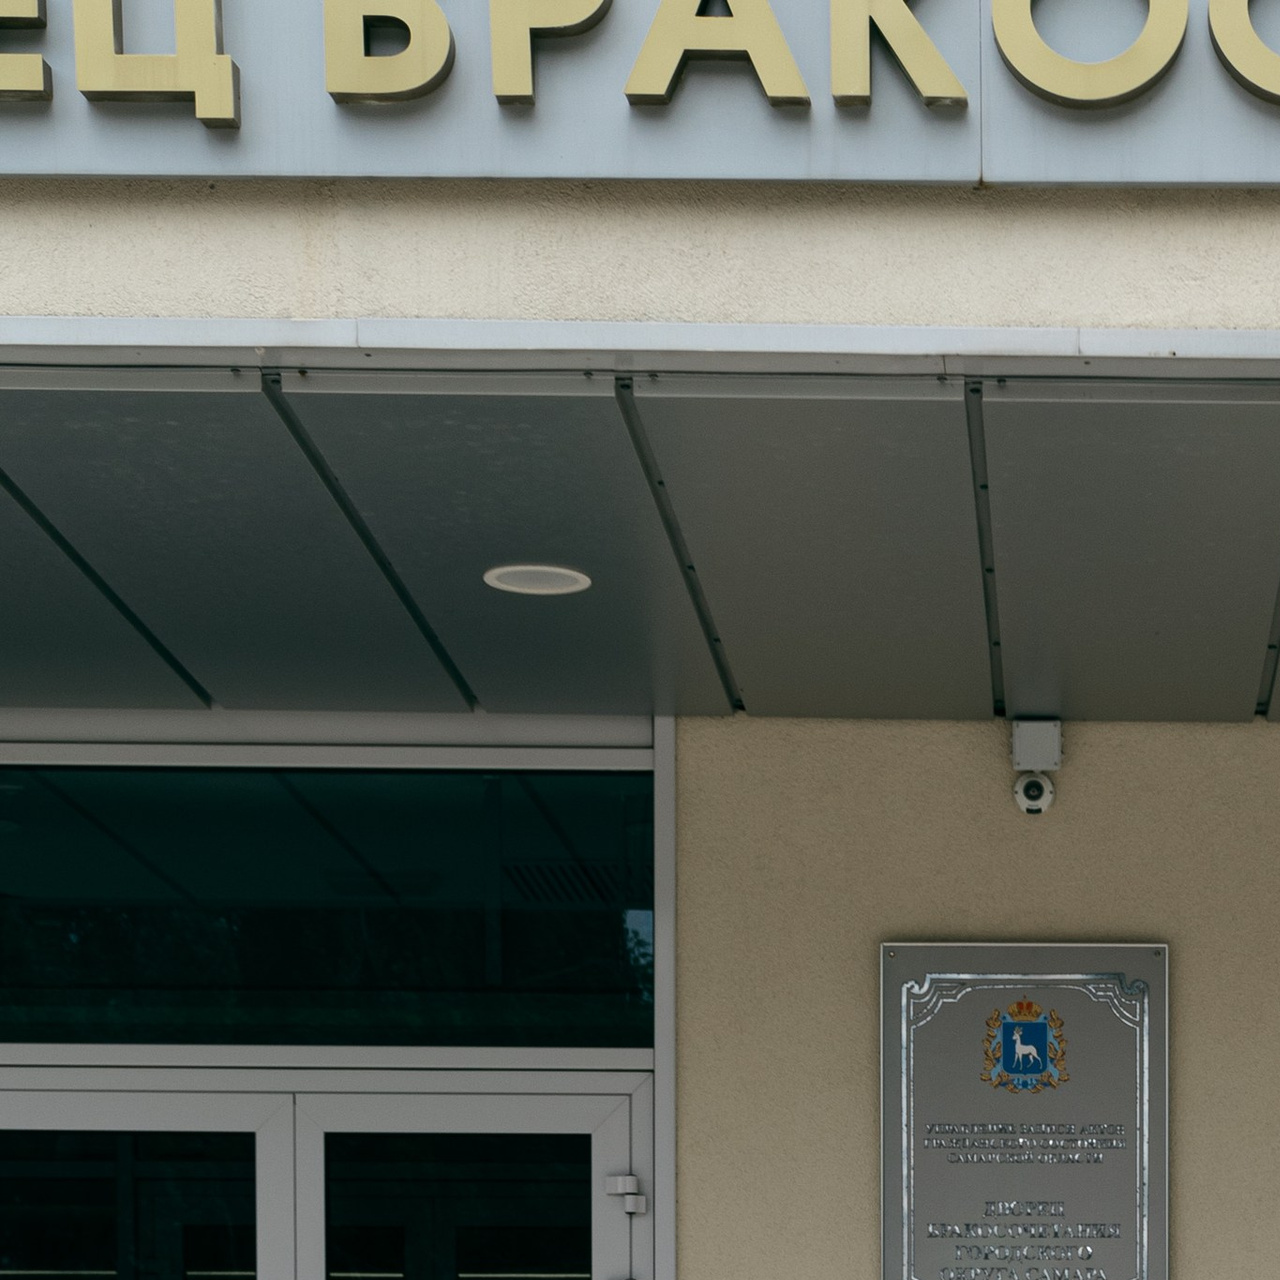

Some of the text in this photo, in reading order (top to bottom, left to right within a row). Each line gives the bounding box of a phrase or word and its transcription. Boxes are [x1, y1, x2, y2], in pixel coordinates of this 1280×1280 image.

[0, 0, 241, 128] Ц
[1079, 1124, 1126, 1135] АКТОВ
[924, 1138, 1127, 1150] ГРАЖДАНСКОГО СОСТОЯНИЯ
[947, 1151, 1104, 1164] САМАРСКОЙ ОБЛАСТИ
[982, 1201, 1065, 1219] ДВОРЕЦ
[927, 1223, 1121, 1238] БРАКОСОЧЕТАНИЯ
[955, 1245, 1093, 1264] ГОРОДСКОГО
